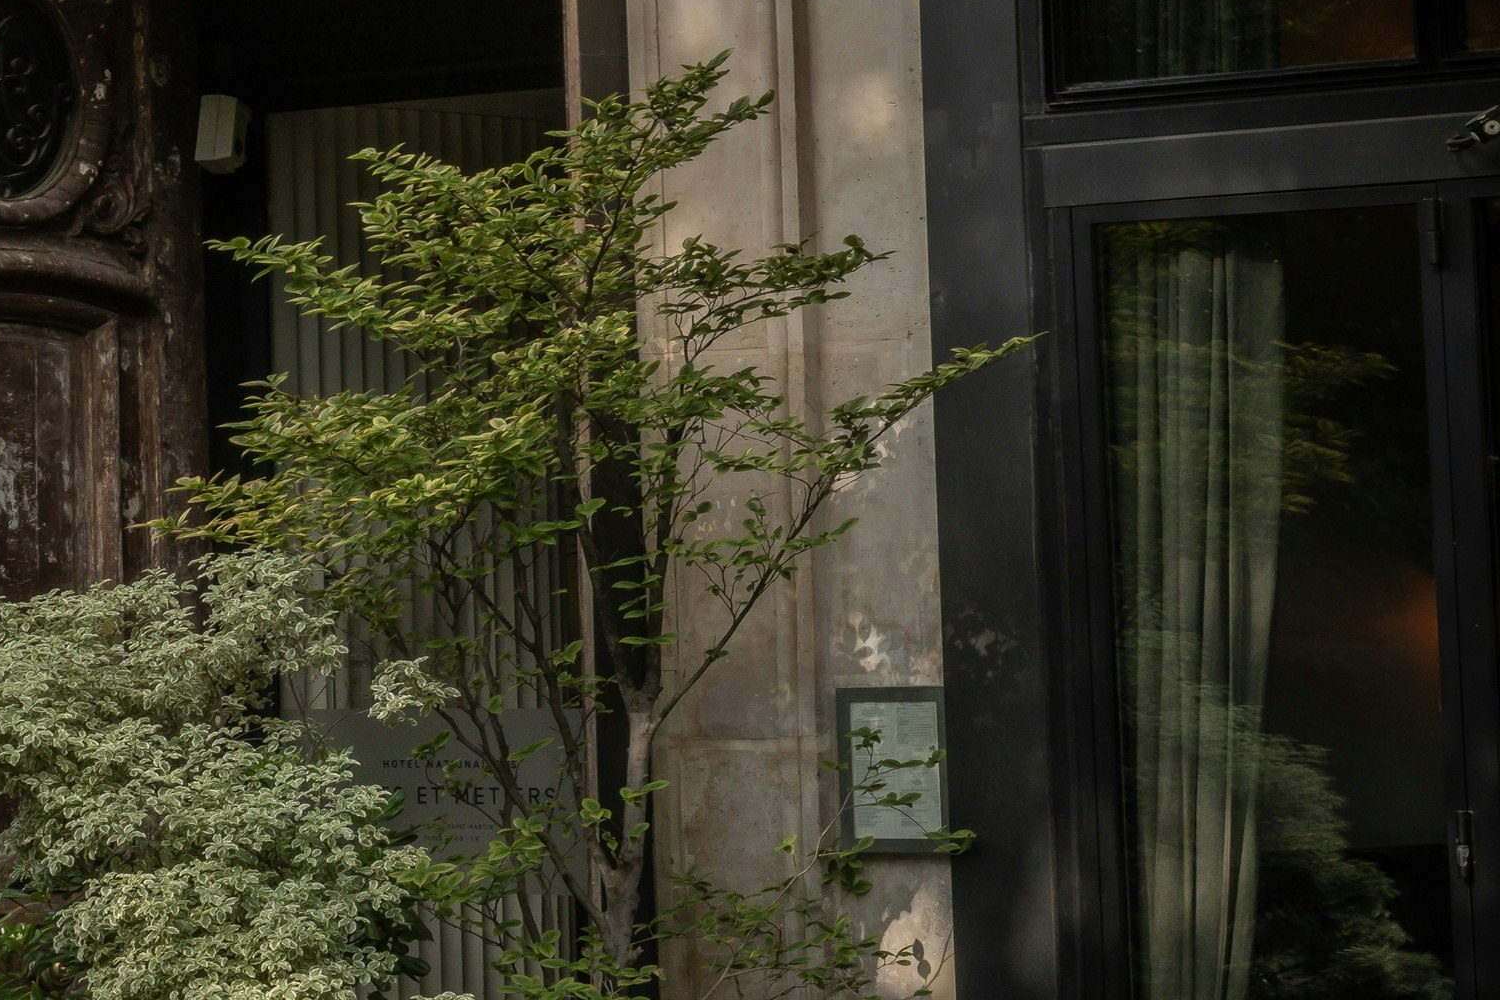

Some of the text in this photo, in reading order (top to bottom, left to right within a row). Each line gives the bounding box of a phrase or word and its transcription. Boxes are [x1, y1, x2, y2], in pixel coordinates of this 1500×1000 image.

[382, 759, 420, 769] HOTEL
[417, 786, 445, 805] ET
[455, 786, 557, 805] METRS
